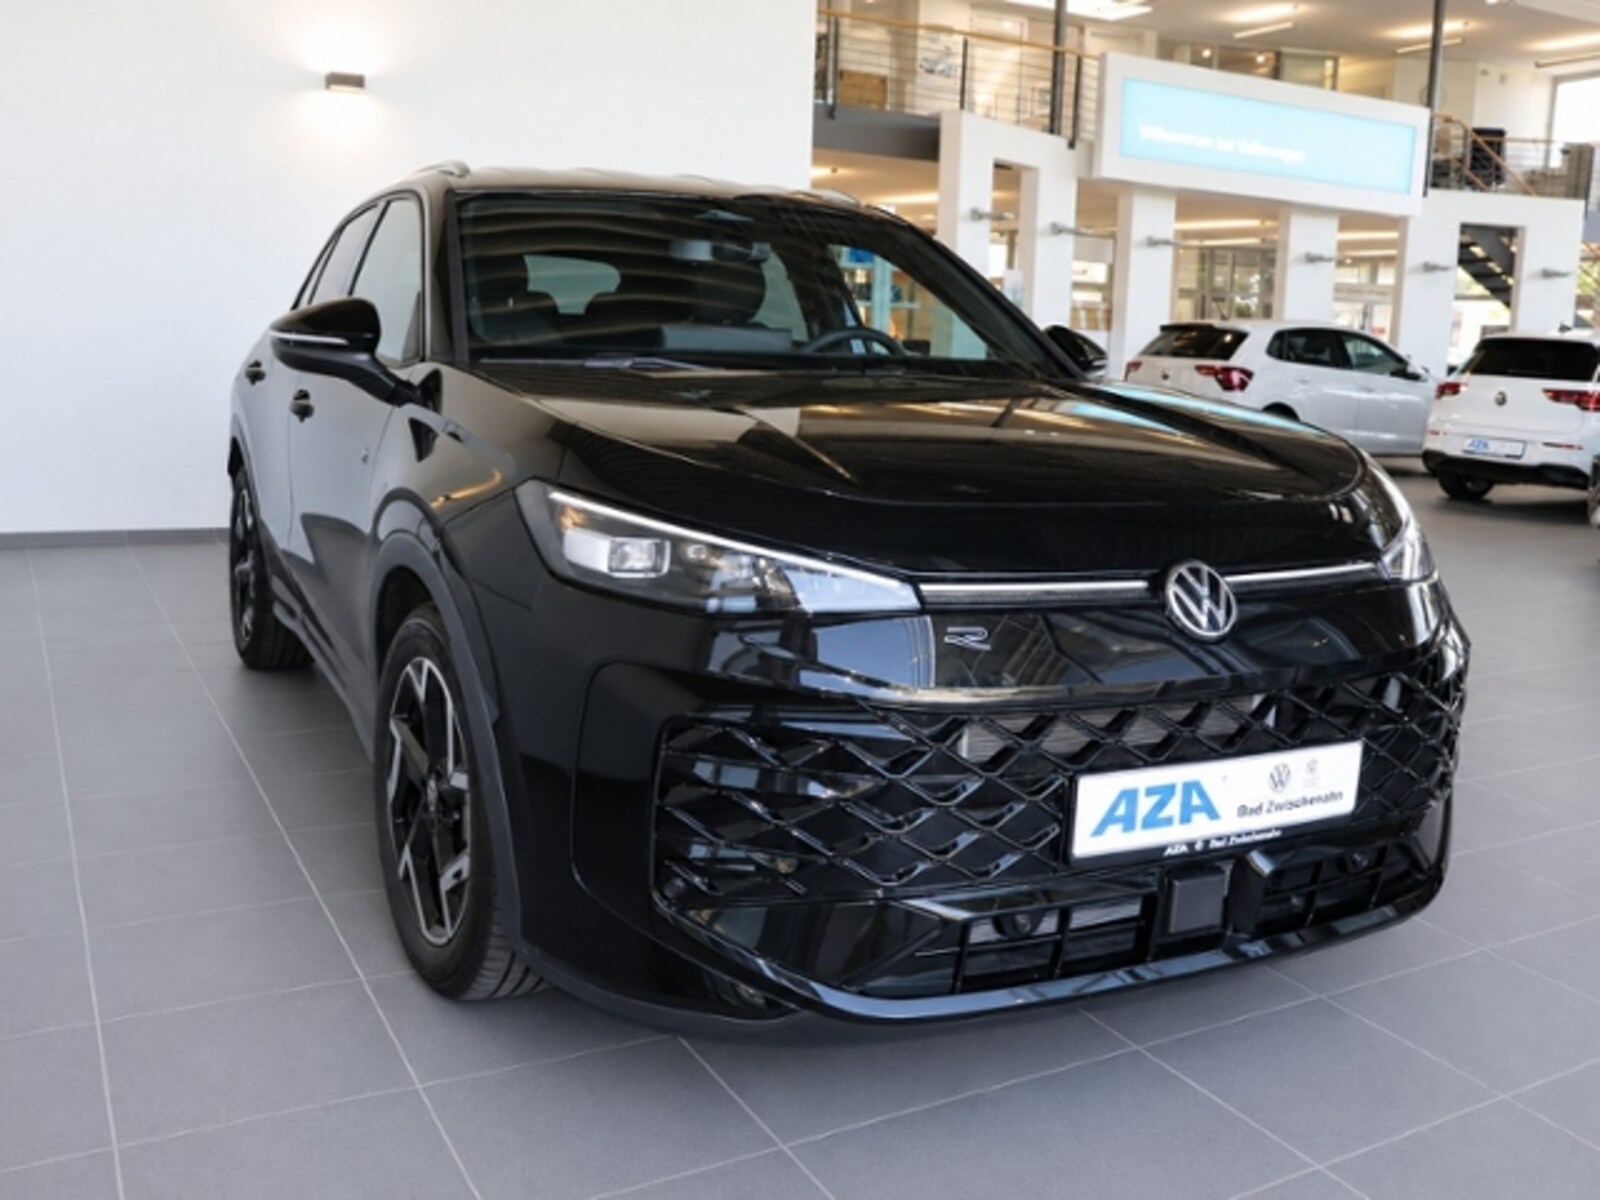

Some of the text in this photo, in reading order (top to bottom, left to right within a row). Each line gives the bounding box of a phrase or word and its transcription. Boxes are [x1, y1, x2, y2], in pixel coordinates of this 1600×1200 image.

[1089, 779, 1221, 838] AZA
[1236, 790, 1344, 818] Bad Zwischenahn
[1163, 844, 1189, 857] AZA
